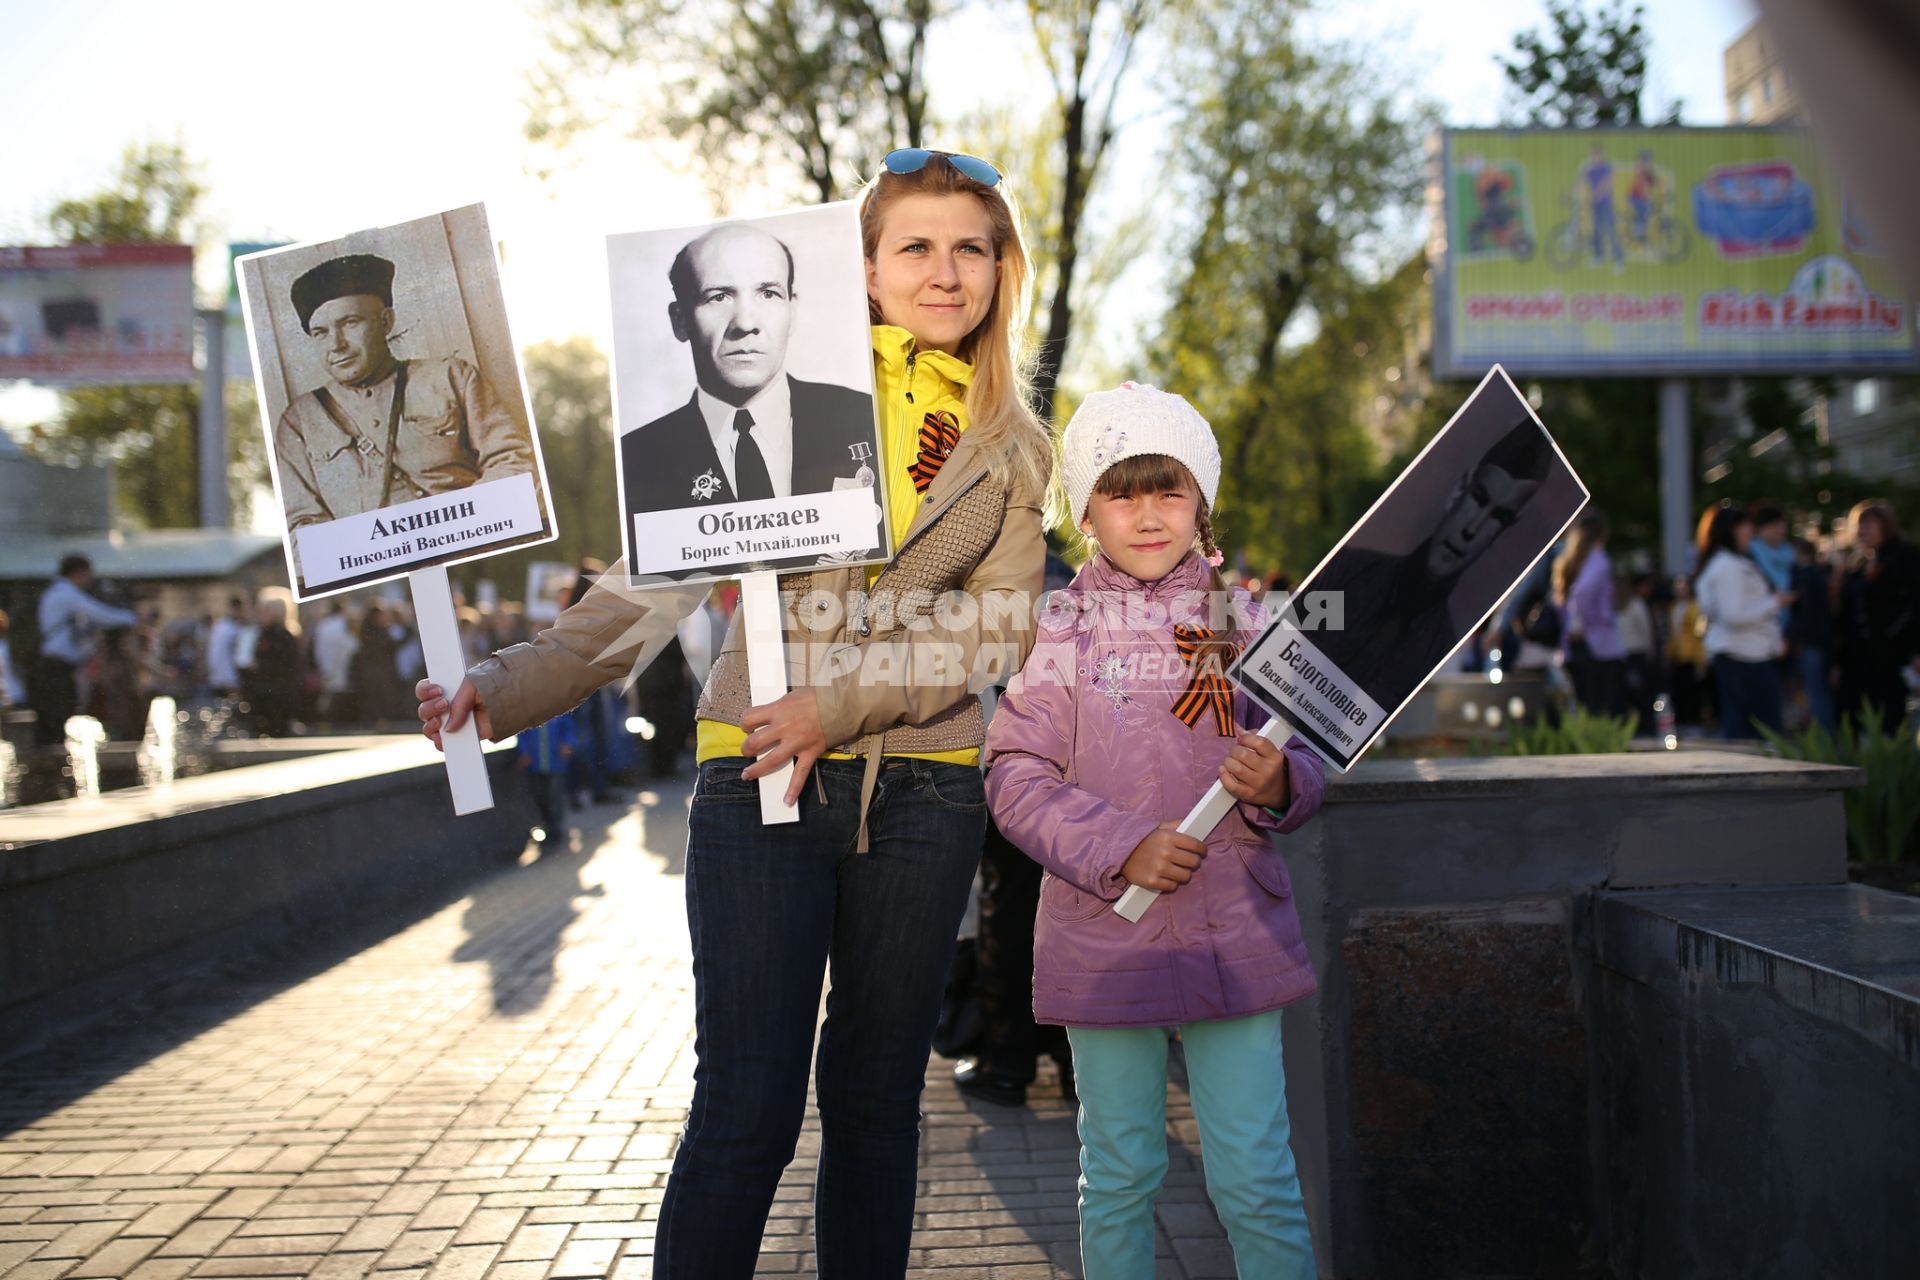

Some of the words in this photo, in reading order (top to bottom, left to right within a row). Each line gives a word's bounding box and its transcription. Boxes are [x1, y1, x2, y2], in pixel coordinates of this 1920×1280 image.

[370, 500, 476, 540] Акинин
[697, 507, 820, 536] Обижаев
[338, 541, 412, 570] Николай
[416, 518, 514, 551] Васильевич
[681, 543, 731, 562] Борис
[736, 533, 841, 556] Михайлович
[1258, 660, 1299, 699] Василий
[1294, 692, 1354, 748] Александрович
[1278, 638, 1368, 727] Белоголовцев
